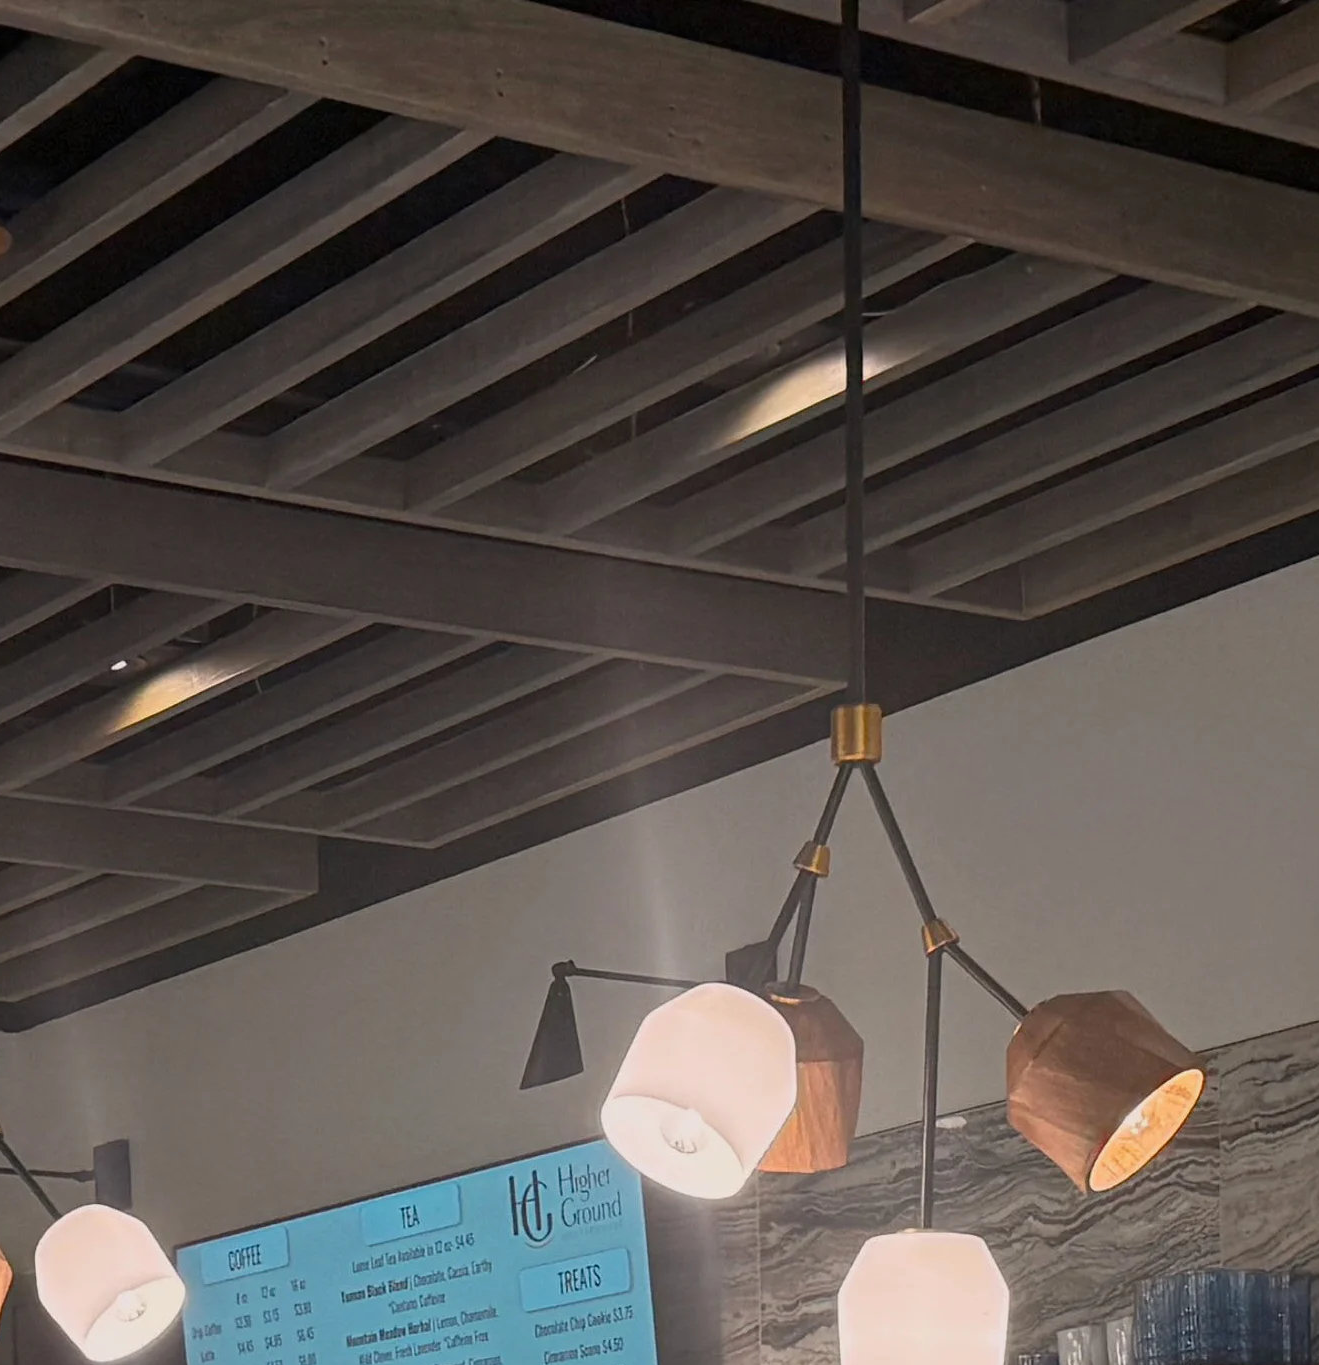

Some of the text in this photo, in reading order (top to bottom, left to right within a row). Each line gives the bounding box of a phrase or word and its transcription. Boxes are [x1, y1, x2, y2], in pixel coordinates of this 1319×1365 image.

[557, 1154, 611, 1207] Higher
[399, 1204, 420, 1229] TEA
[560, 1185, 622, 1229] Ground
[227, 1243, 262, 1271] COFFEE
[557, 1263, 602, 1294] TREATS
[534, 1318, 568, 1338] Chocolate
